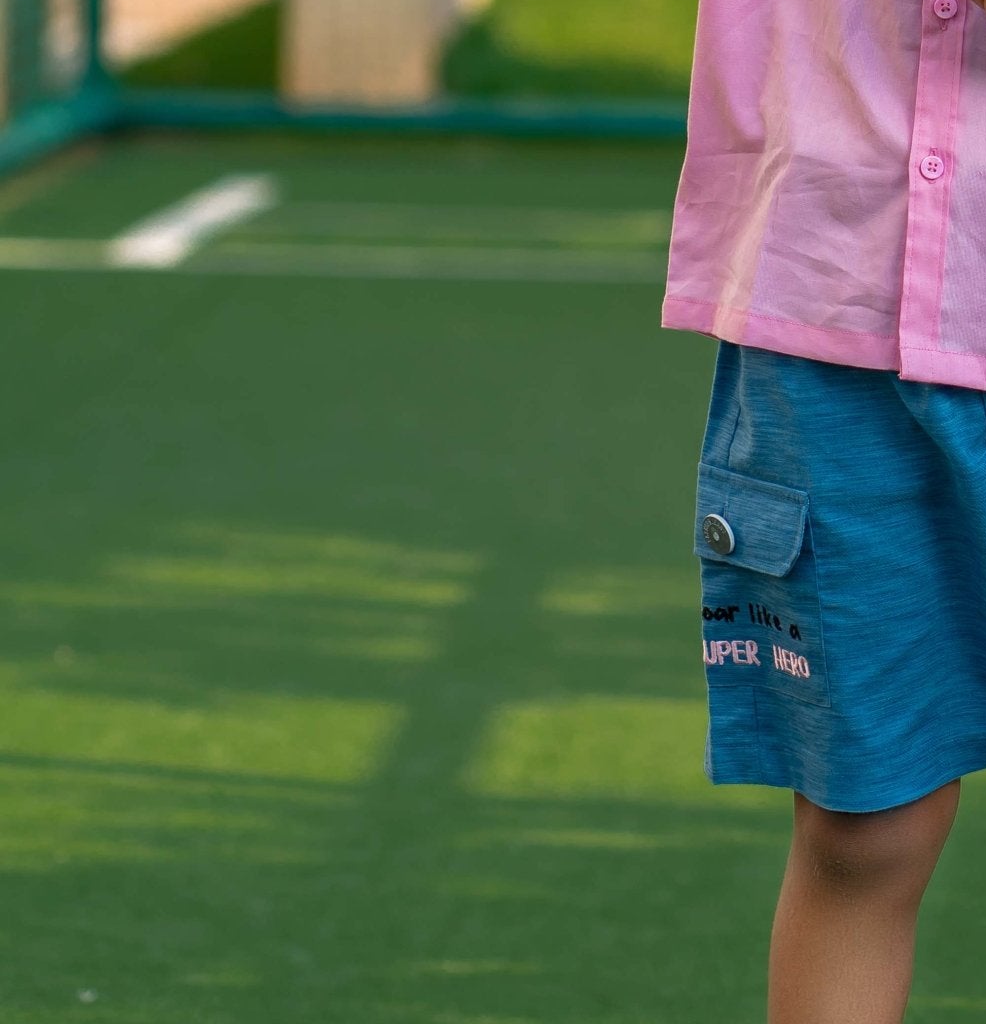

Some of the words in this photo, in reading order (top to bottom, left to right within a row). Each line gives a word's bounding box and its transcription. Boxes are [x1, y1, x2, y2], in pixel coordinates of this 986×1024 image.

[748, 602, 782, 632] like
[789, 627, 802, 641] a
[772, 642, 811, 679] HERO
